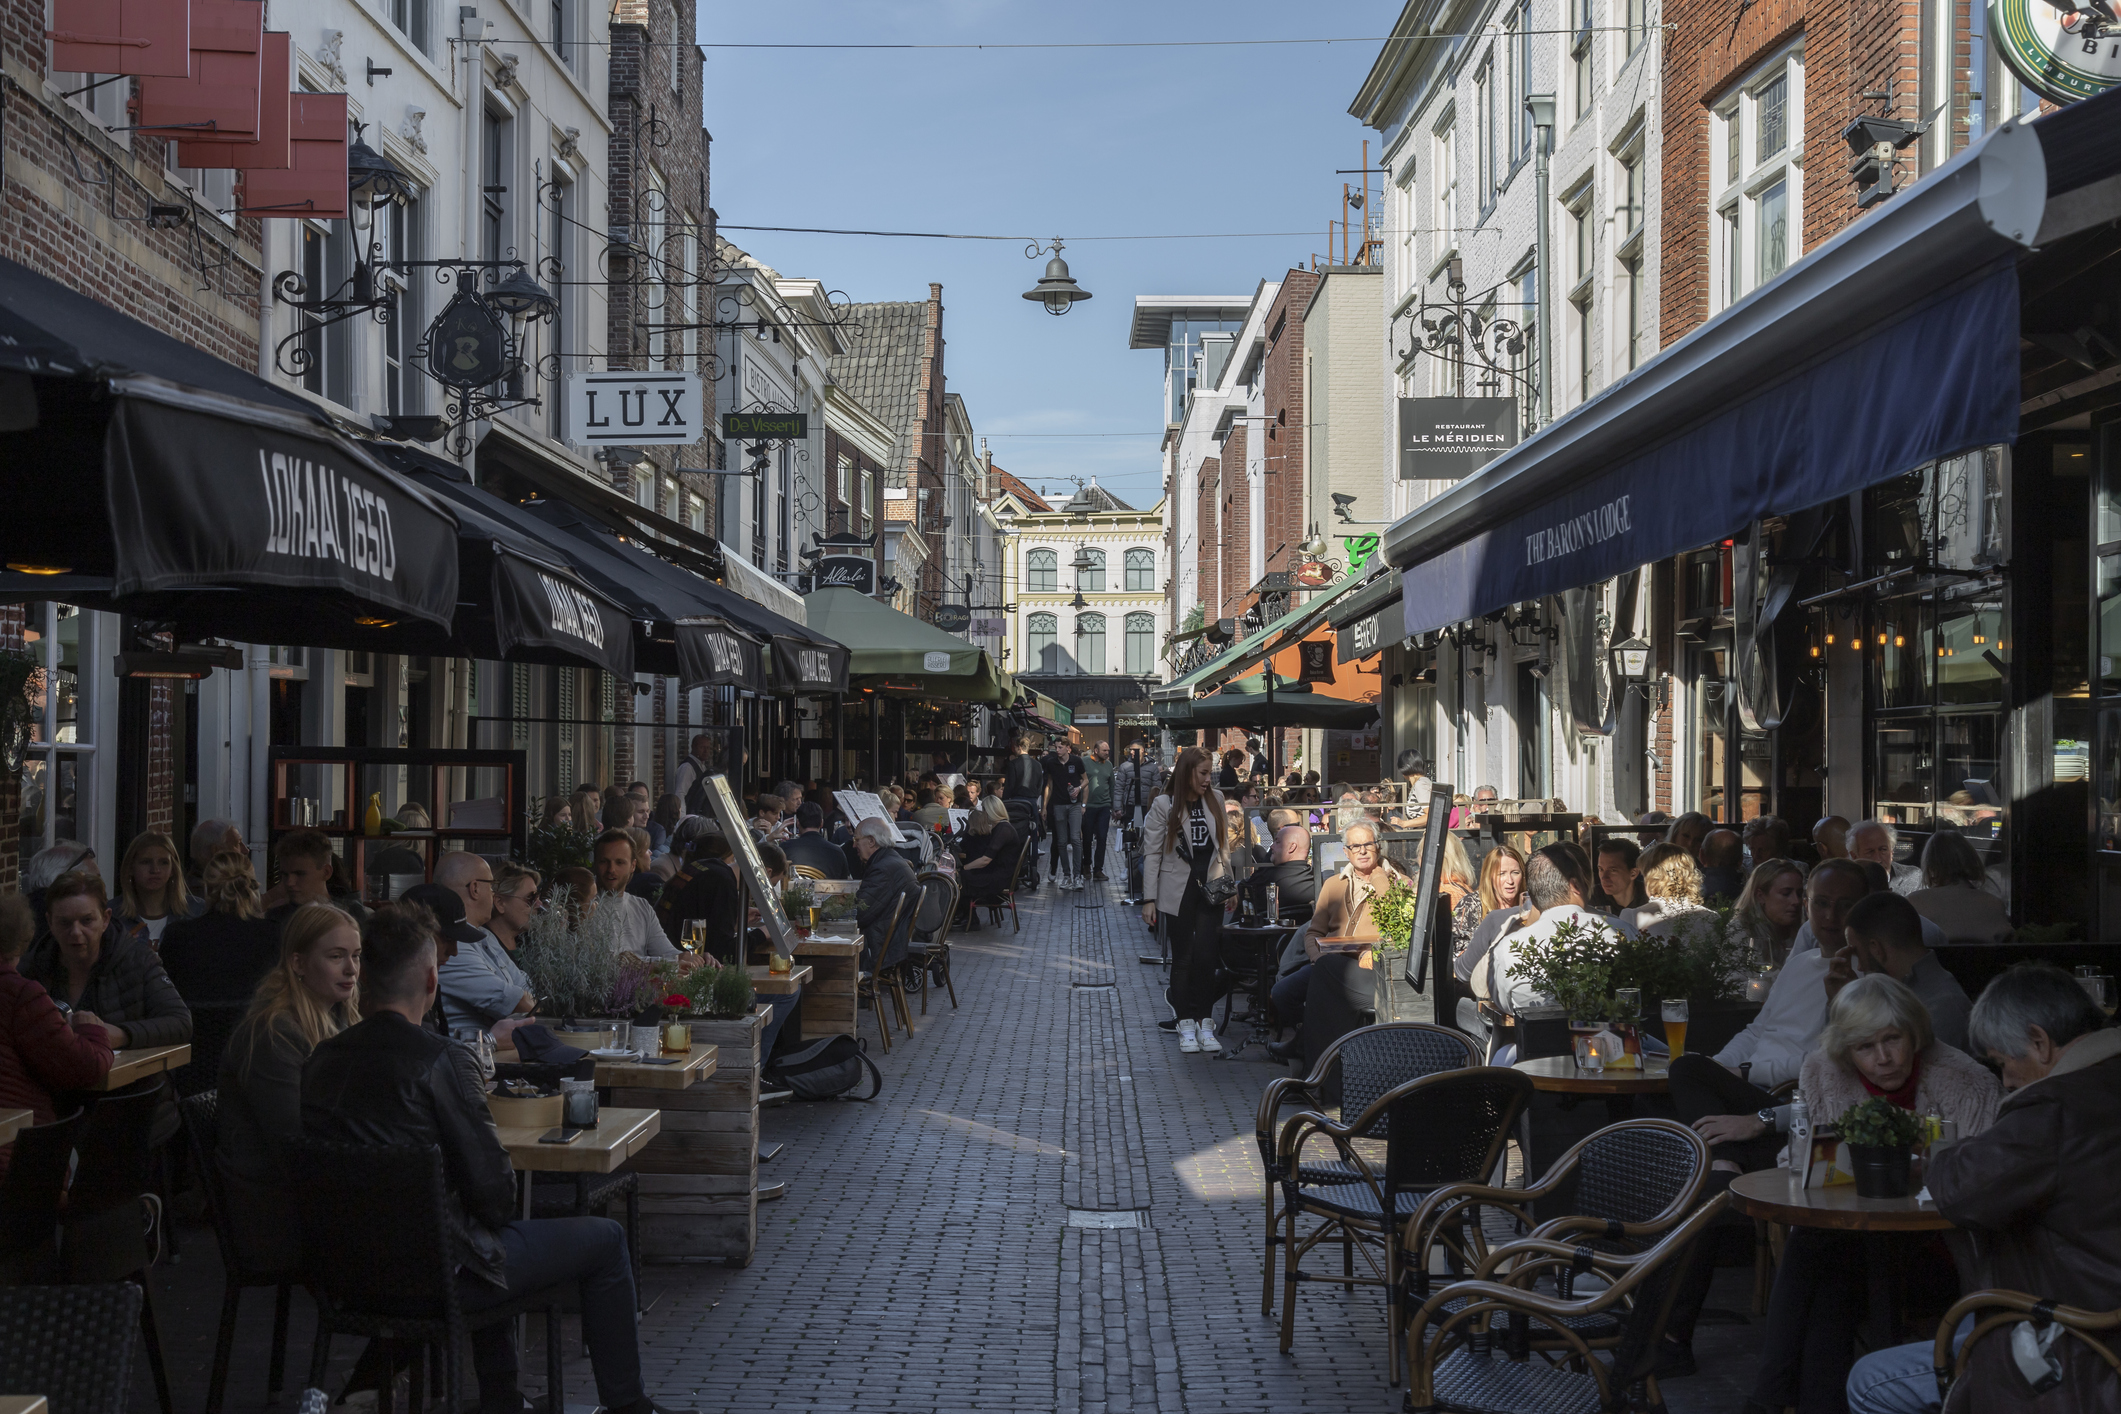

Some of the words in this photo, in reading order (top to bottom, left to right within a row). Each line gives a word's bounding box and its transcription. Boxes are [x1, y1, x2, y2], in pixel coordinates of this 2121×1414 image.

[750, 367, 771, 403] BISTRO
[585, 389, 687, 427] LUX
[730, 417, 750, 433] De
[1412, 434, 1430, 443] LE
[1434, 431, 1505, 442] MÉRIDIEN
[259, 448, 346, 564] LOKAAL
[342, 476, 396, 582] 1650
[1526, 530, 1546, 566] THE
[1546, 511, 1594, 560] BARON'S
[1593, 494, 1632, 544] LODGE
[822, 565, 866, 585] Allerlei
[537, 571, 584, 640] LOKAAL
[570, 587, 605, 651] 1650
